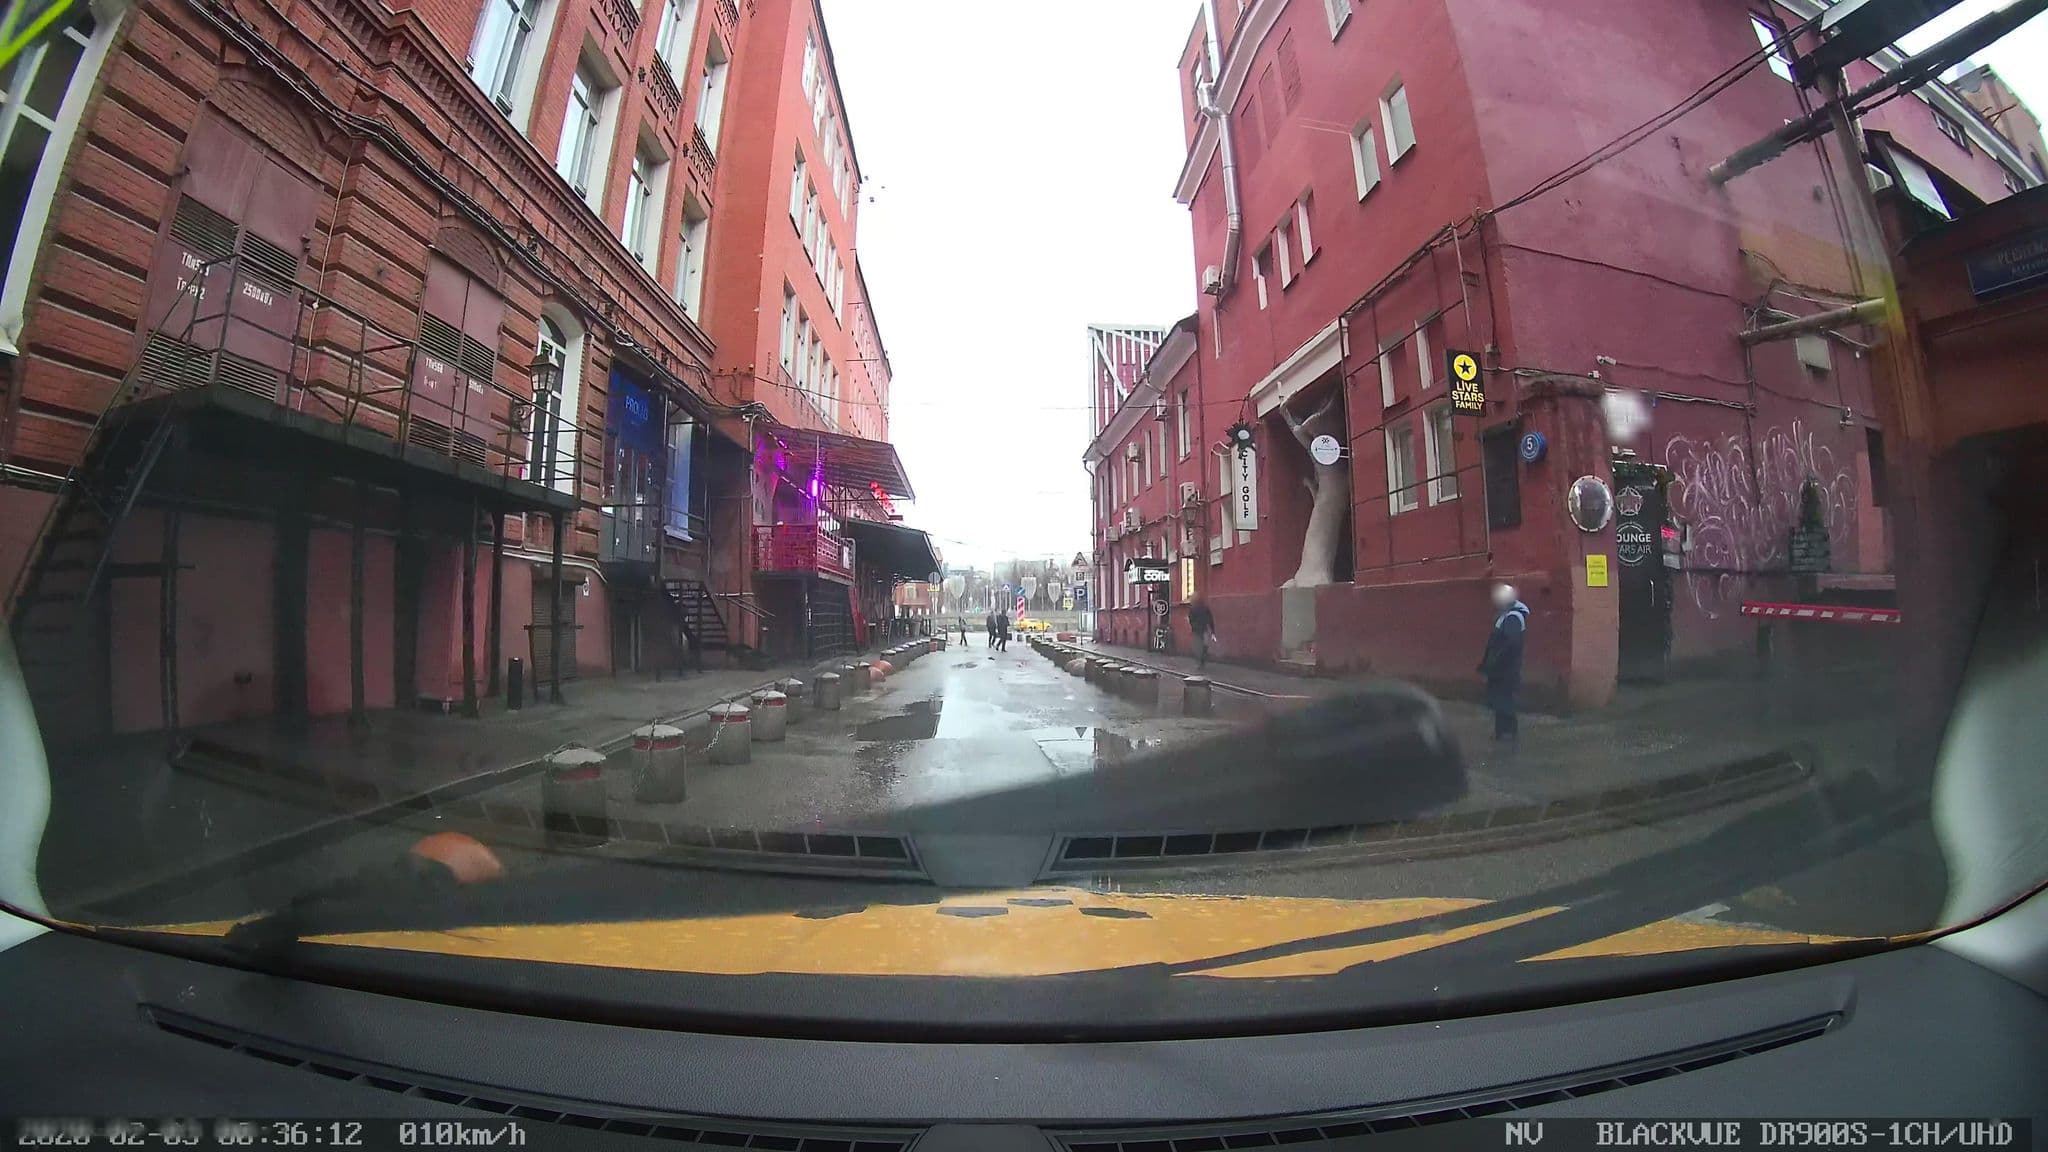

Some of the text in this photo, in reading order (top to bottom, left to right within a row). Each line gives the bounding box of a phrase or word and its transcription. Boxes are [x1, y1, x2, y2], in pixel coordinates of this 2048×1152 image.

[1456, 380, 1479, 392] LIVE
[1451, 390, 1485, 403] STARS
[1455, 400, 1483, 410] FAMILY
[1526, 437, 1533, 450] 5
[1241, 450, 1250, 519] CITY GOLF
[1616, 533, 1652, 543] OUNGE
